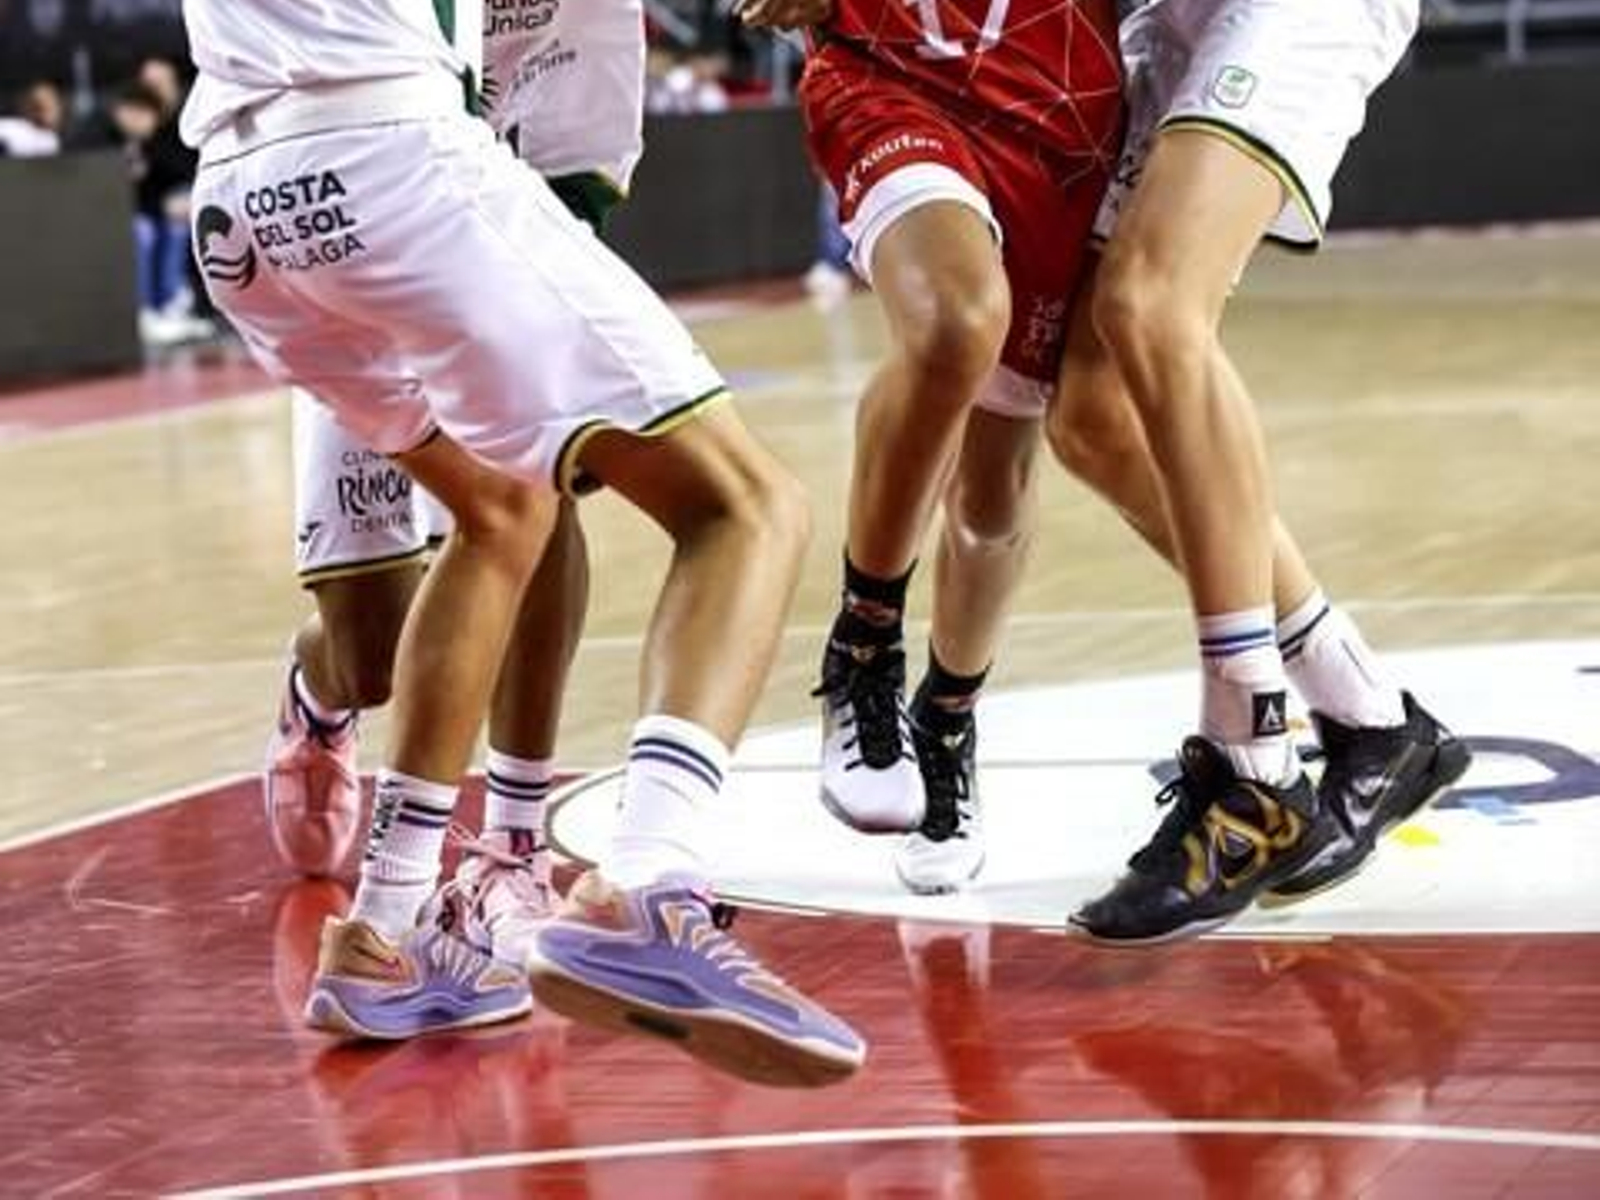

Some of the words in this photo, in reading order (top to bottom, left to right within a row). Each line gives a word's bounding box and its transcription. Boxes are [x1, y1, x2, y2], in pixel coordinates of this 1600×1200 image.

[244, 169, 347, 220] COSTA
[253, 221, 294, 250] DEL
[293, 204, 356, 241] SOL
